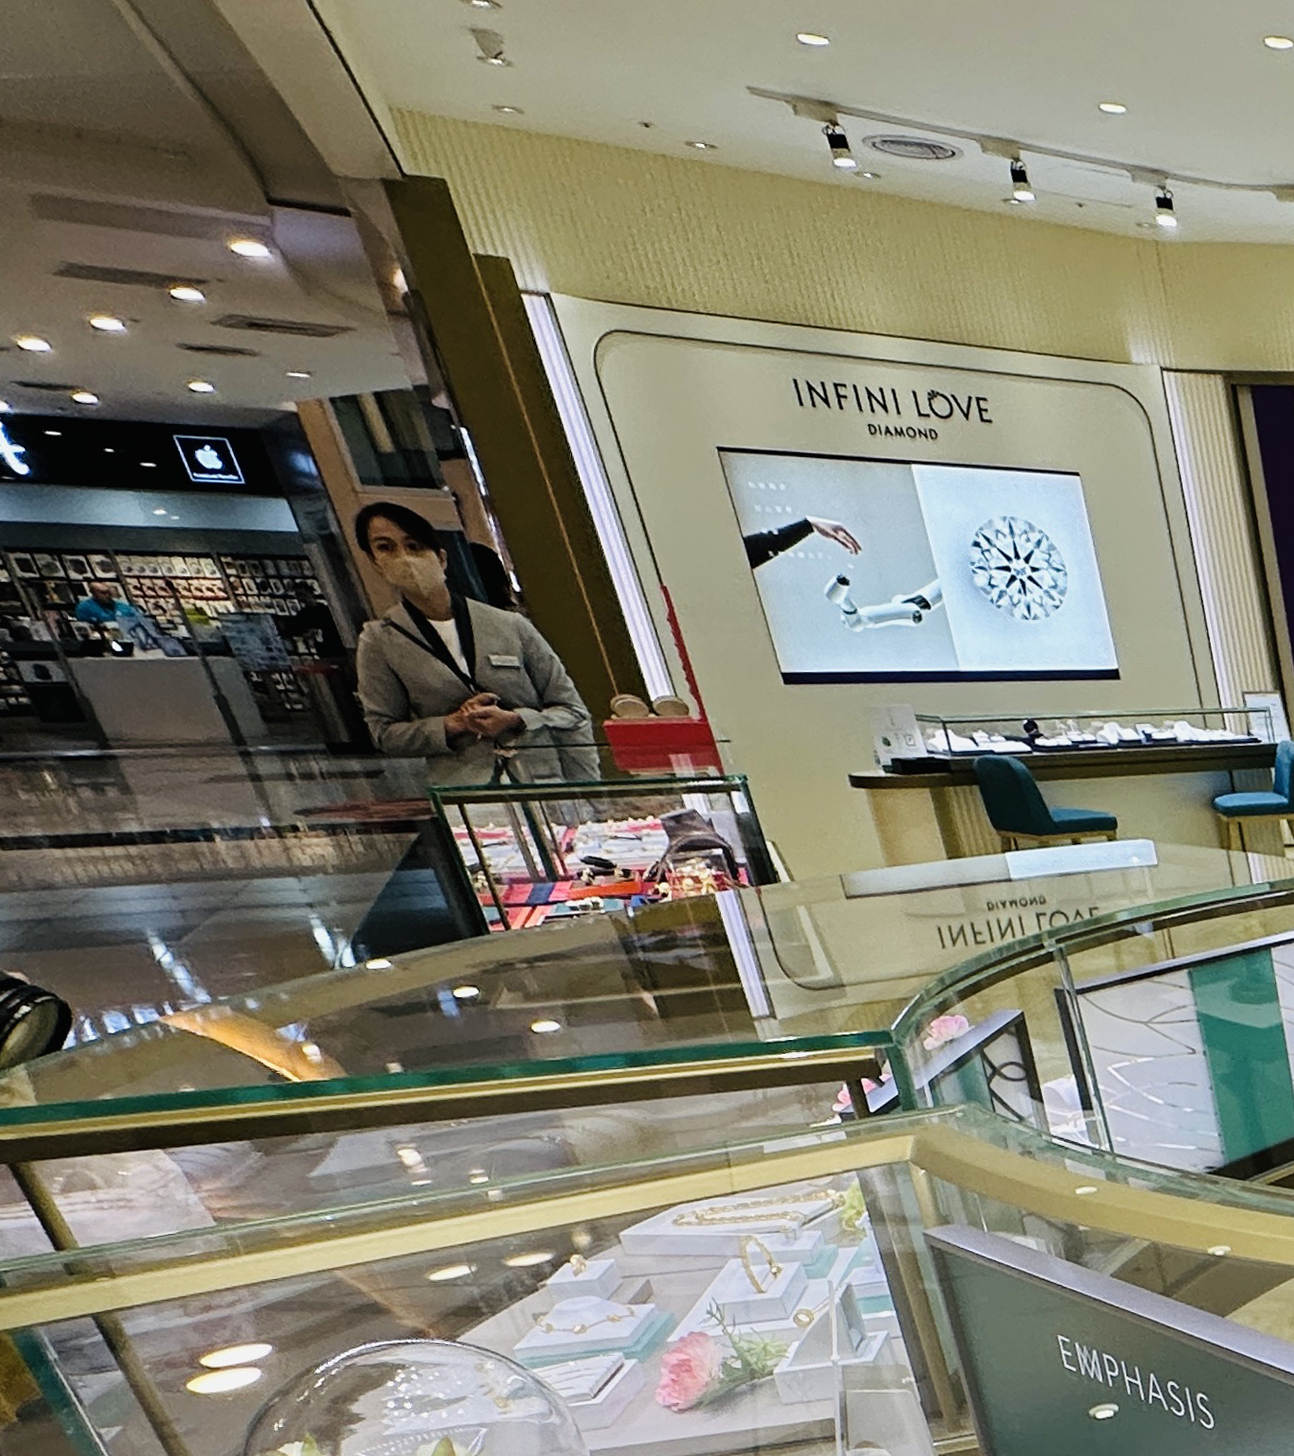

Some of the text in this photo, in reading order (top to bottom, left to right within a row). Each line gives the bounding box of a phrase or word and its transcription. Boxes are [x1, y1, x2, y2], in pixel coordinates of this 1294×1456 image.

[792, 378, 993, 424] INFINI LOVE
[867, 423, 938, 441] DIAMOND
[1056, 1334, 1215, 1430] EMPHASIS
